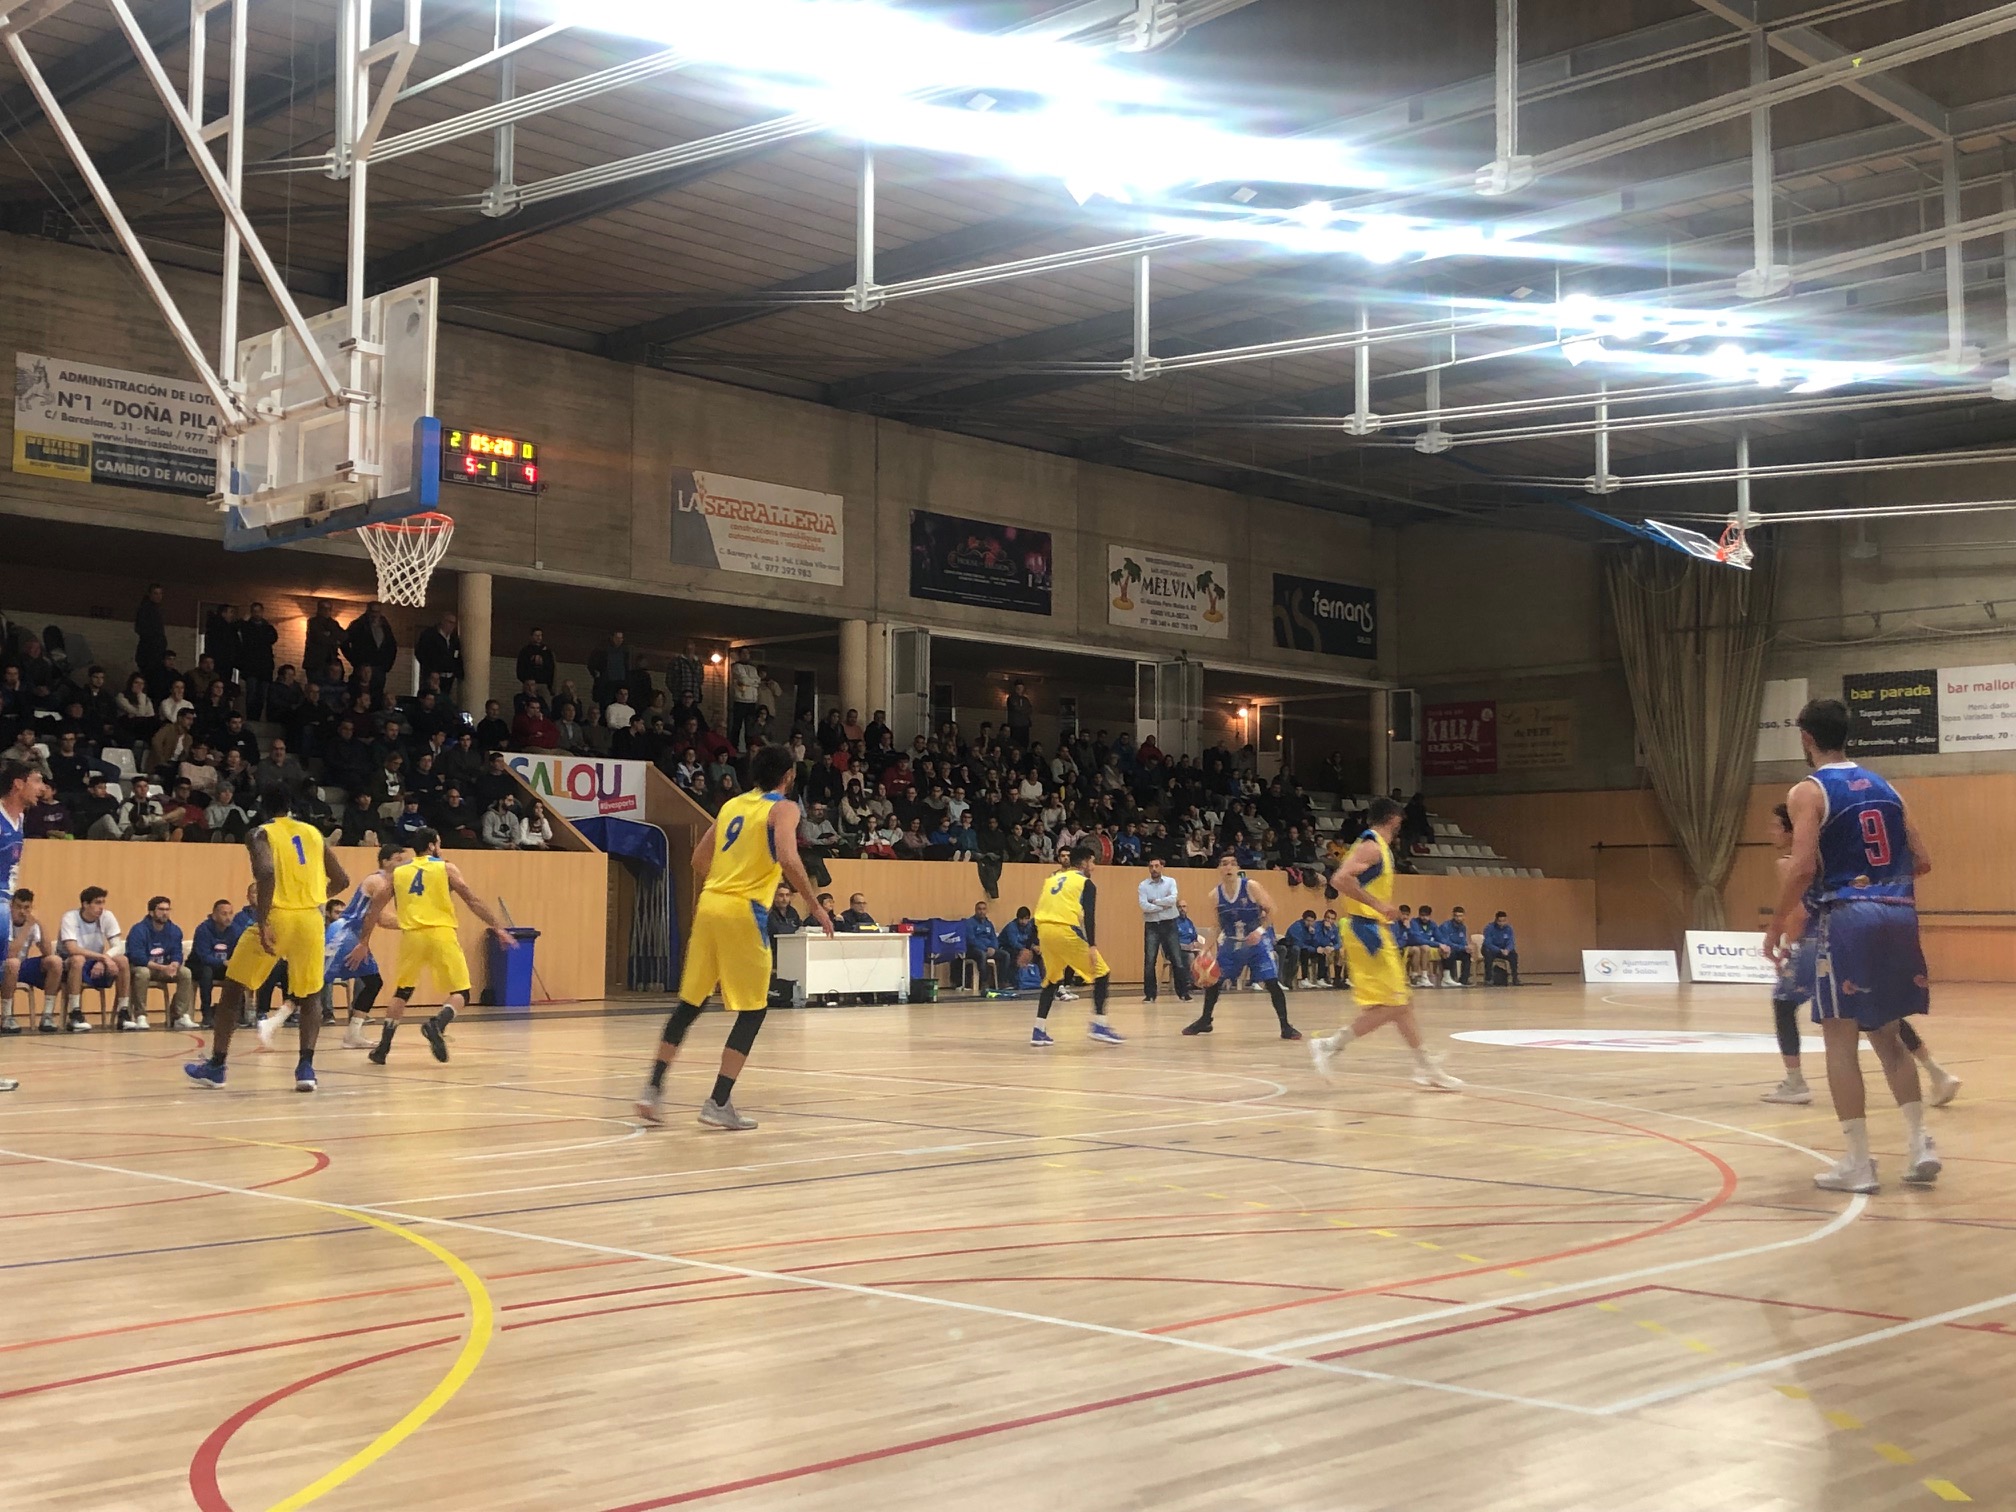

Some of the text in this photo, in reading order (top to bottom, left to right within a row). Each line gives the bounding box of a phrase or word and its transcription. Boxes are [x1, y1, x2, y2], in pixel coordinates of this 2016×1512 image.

[59, 370, 167, 398] ADMINISTRACIÓN
[171, 389, 186, 401] DE
[45, 409, 58, 420] C/
[61, 412, 117, 430] Barcelona,
[120, 422, 133, 432] 31
[145, 425, 173, 438] Salou
[184, 432, 204, 442] 977
[450, 431, 461, 448] 2
[470, 434, 514, 456] 05:20
[94, 459, 151, 478] CAMBIO
[154, 467, 171, 480] DE
[465, 457, 476, 473] 5
[524, 466, 535, 482] 9
[1140, 576, 1196, 600] MELVIN
[1850, 684, 1932, 701] bar parada
[1947, 679, 2016, 694] bar mallor
[1859, 709, 1883, 719] Tapas
[1857, 738, 1897, 746] Barcelona,
[1915, 735, 1937, 743] Salou
[1944, 733, 1955, 742] C/
[1955, 733, 1996, 742] Barcelona,
[509, 757, 622, 801] SALOU
[600, 799, 635, 810] #livesports
[722, 815, 744, 852] 9
[1859, 809, 1891, 867] 9
[292, 835, 306, 865] 1
[408, 868, 425, 896] 4
[1050, 876, 1067, 895] 3
